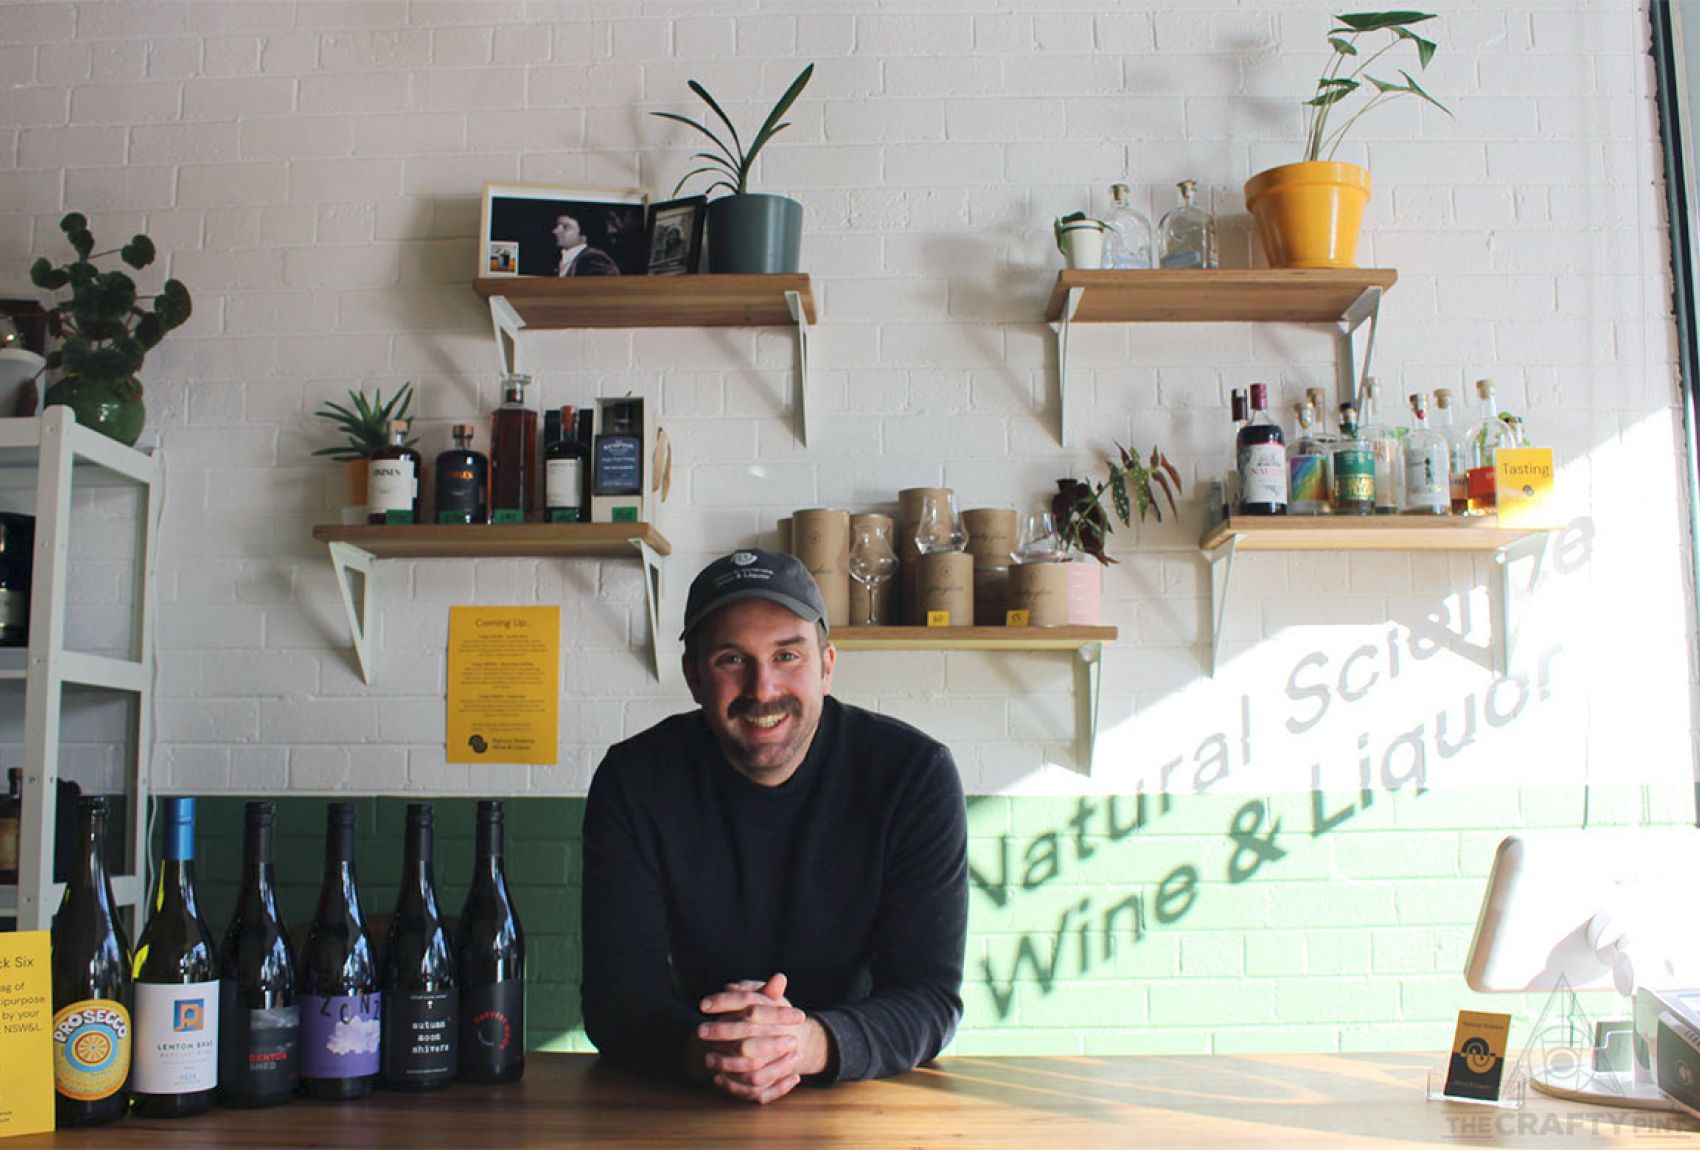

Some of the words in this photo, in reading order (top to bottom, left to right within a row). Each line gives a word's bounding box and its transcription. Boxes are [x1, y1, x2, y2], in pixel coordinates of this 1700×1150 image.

[1502, 463, 1551, 478] Tasting
[475, 618, 512, 629] Coming
[967, 694, 1251, 908] Natural
[1284, 515, 1596, 734] Sciee
[978, 864, 1199, 1021] Wine
[1227, 799, 1288, 884] &
[1310, 641, 1564, 838] Liquor
[15, 956, 34, 968] Six
[15, 981, 25, 991] of
[3, 1012, 14, 1022] by
[18, 1010, 40, 1020] your
[53, 1009, 129, 1042] PROSECCO
[157, 1042, 194, 1051] LENTON
